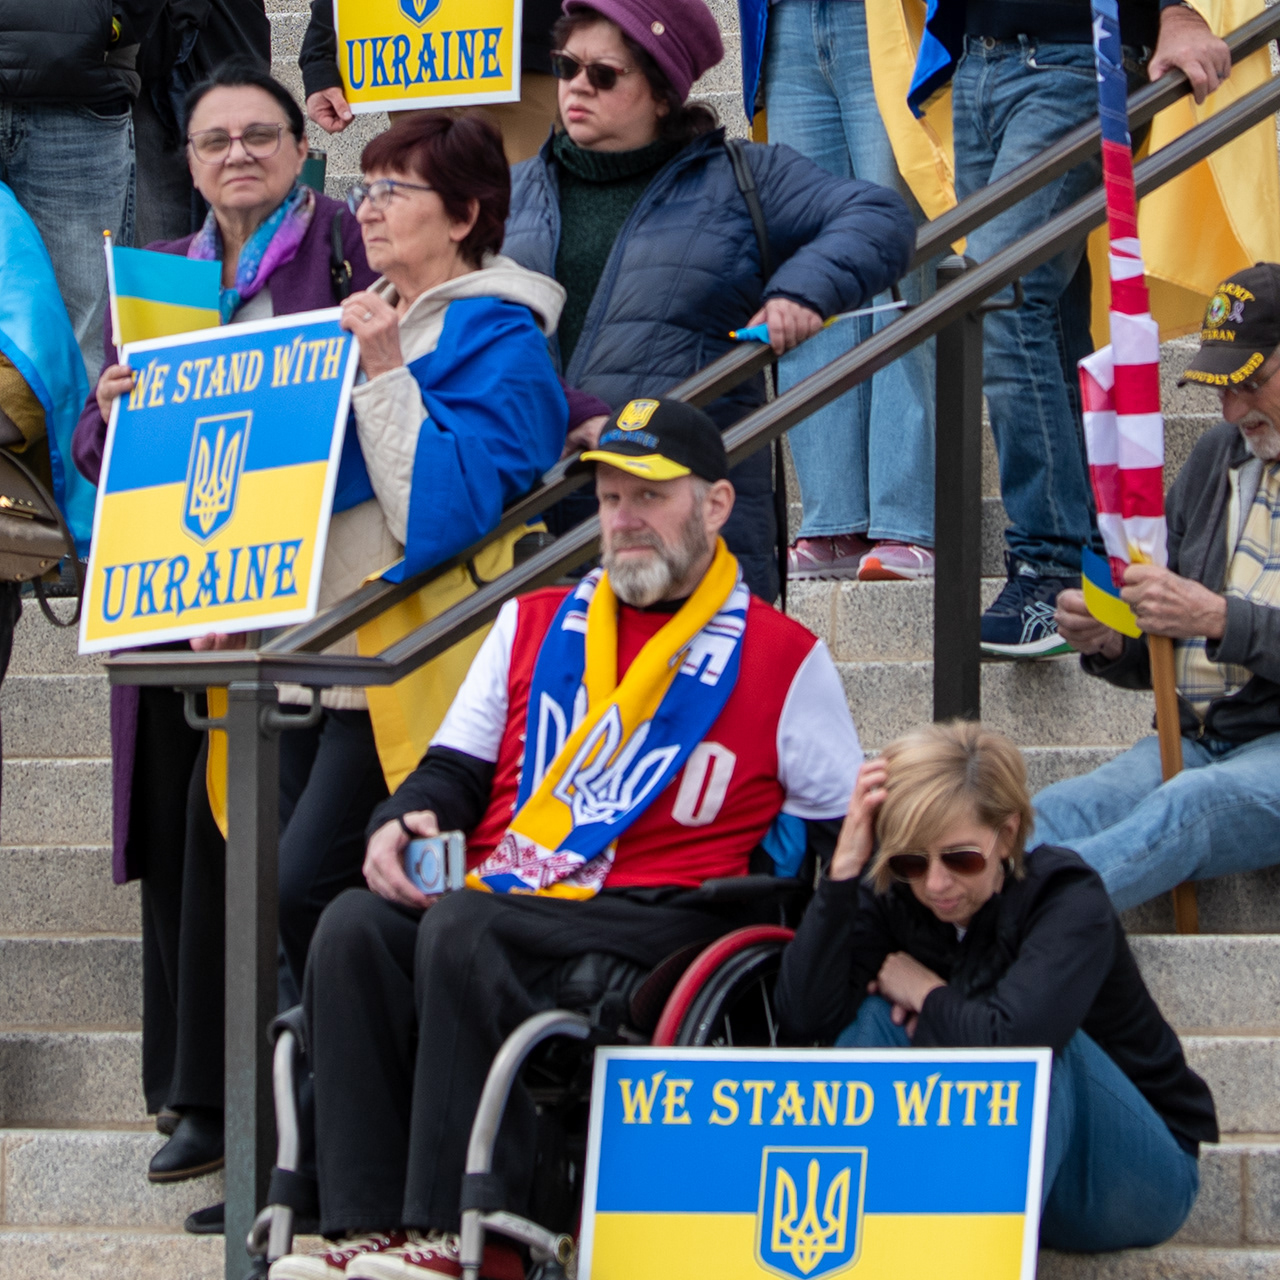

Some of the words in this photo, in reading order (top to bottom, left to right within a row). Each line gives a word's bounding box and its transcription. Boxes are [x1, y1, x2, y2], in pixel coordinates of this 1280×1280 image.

[346, 27, 503, 91] UKRAINE
[127, 358, 170, 411] WE
[172, 349, 264, 404] STAND
[271, 333, 345, 388] WITH
[101, 538, 304, 623] UKRAINE
[618, 1071, 694, 1125] WE
[708, 1078, 875, 1126] STAND
[893, 1072, 1020, 1127] WITH
